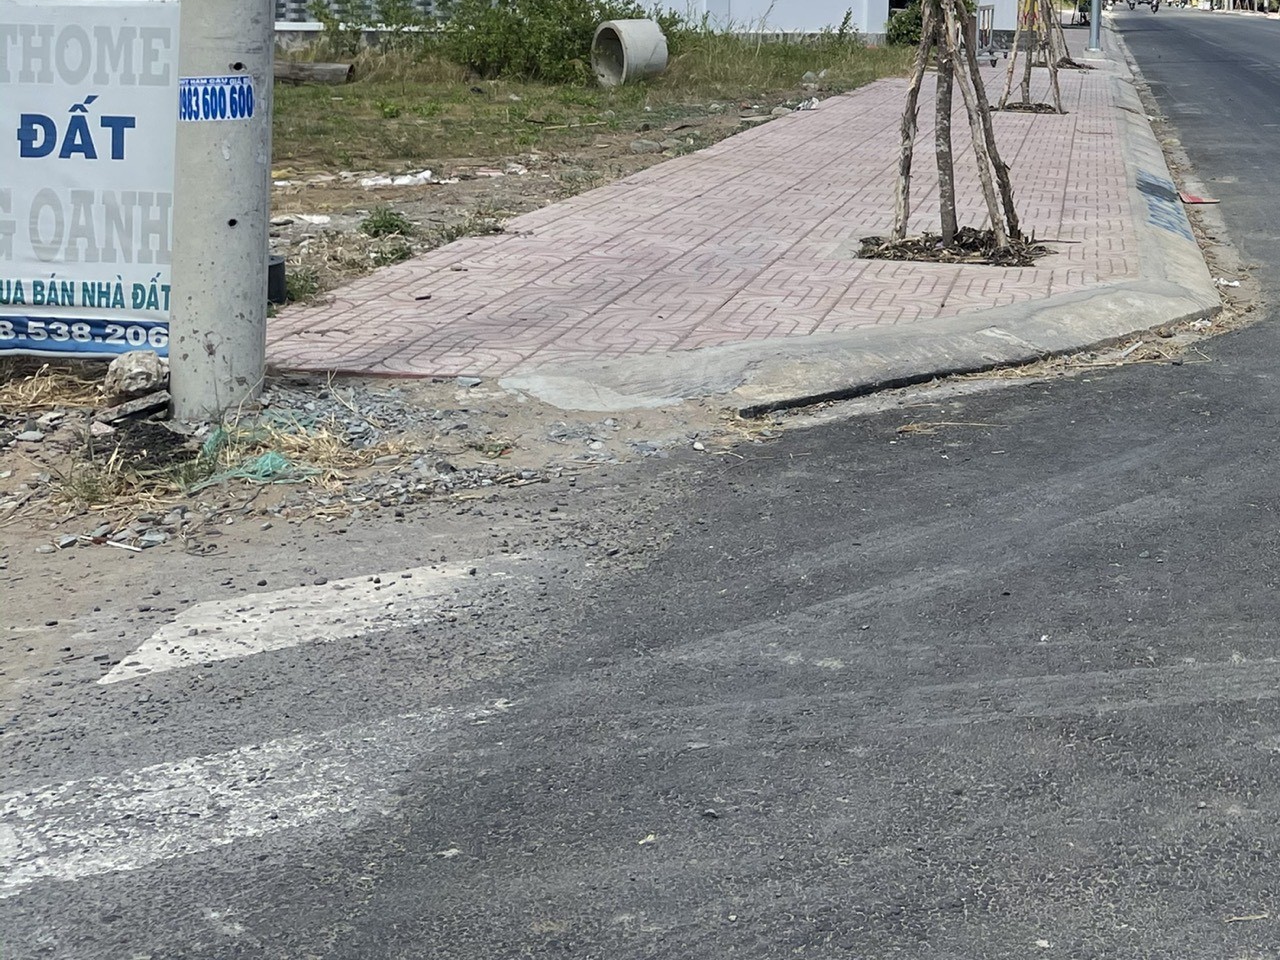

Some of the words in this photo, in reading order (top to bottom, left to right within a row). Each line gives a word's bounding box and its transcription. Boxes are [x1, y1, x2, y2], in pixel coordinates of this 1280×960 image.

[17, 95, 136, 160] ĐẤT
[29, 187, 172, 264] OANH
[33, 273, 75, 307] BÁN
[82, 275, 125, 309] NHÀ
[132, 272, 171, 311] ĐẤT
